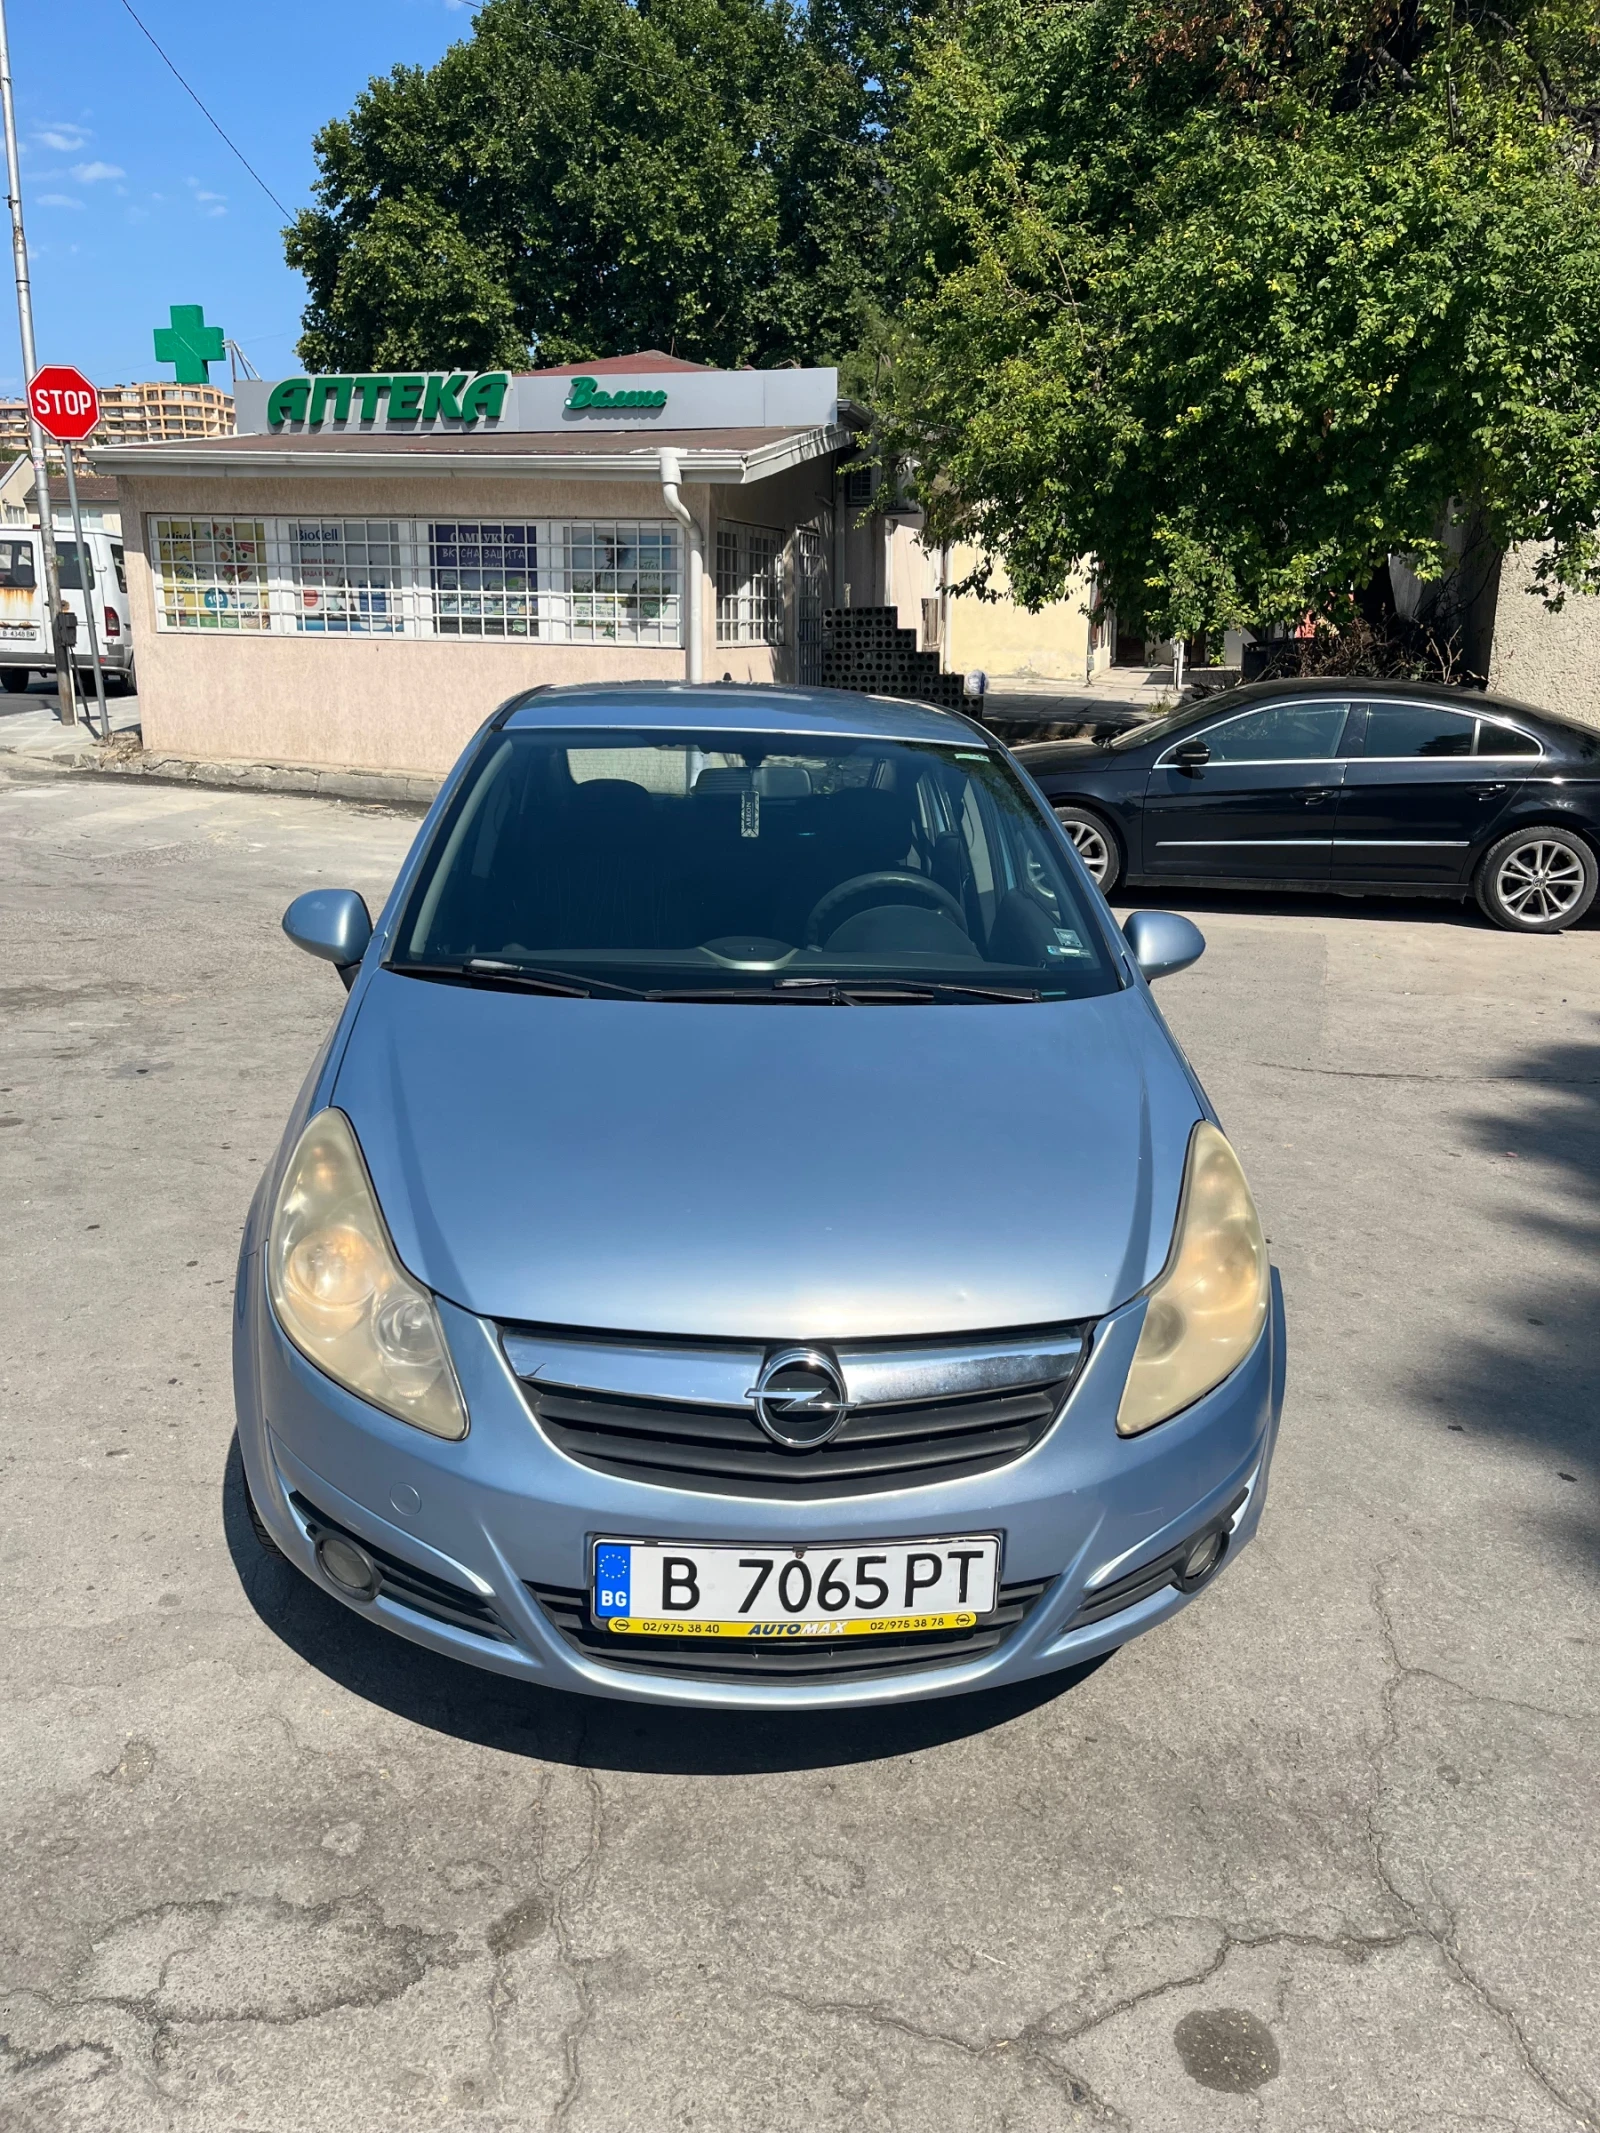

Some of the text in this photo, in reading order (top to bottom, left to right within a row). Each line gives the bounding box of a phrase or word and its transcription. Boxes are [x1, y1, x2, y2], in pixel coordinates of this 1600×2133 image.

[35, 388, 92, 415] STOP
[268, 371, 509, 426] АПТЕКА
[295, 529, 338, 541] BioCell
[662, 1550, 984, 1614] B 7065 PT
[601, 1589, 627, 1608] BG
[642, 1622, 720, 1634] 02/975 38 40
[747, 1621, 849, 1636] AUTOMAX
[869, 1617, 945, 1631] 02/975 38 78
